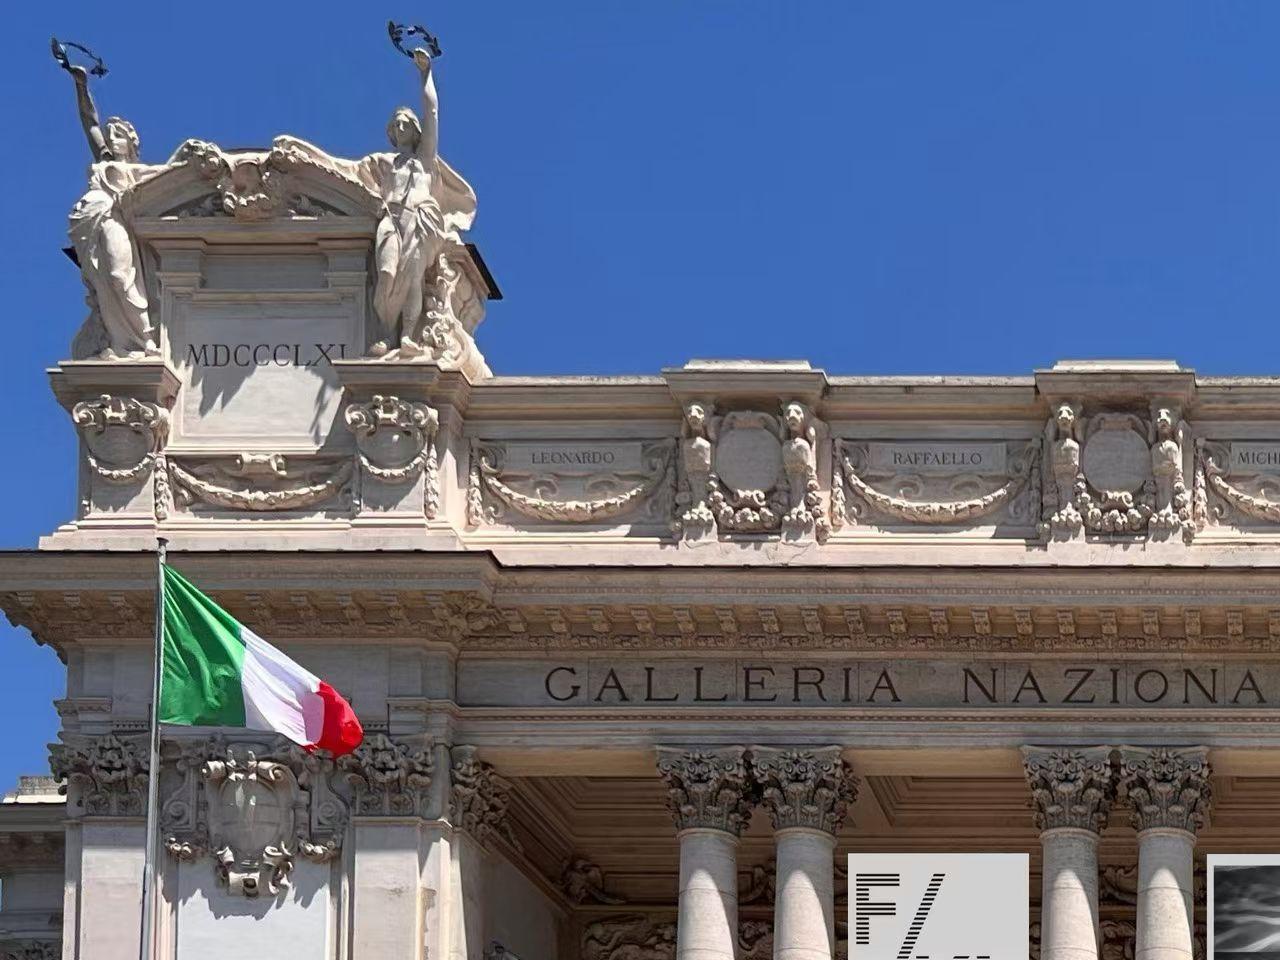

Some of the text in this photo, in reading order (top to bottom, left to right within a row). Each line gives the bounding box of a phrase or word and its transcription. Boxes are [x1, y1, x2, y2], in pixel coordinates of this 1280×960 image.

[185, 343, 352, 367] MDCCCLXI
[531, 451, 615, 464] LEONARDO
[893, 452, 982, 465] RAFFAELLO
[544, 666, 901, 702] GALLERIA
